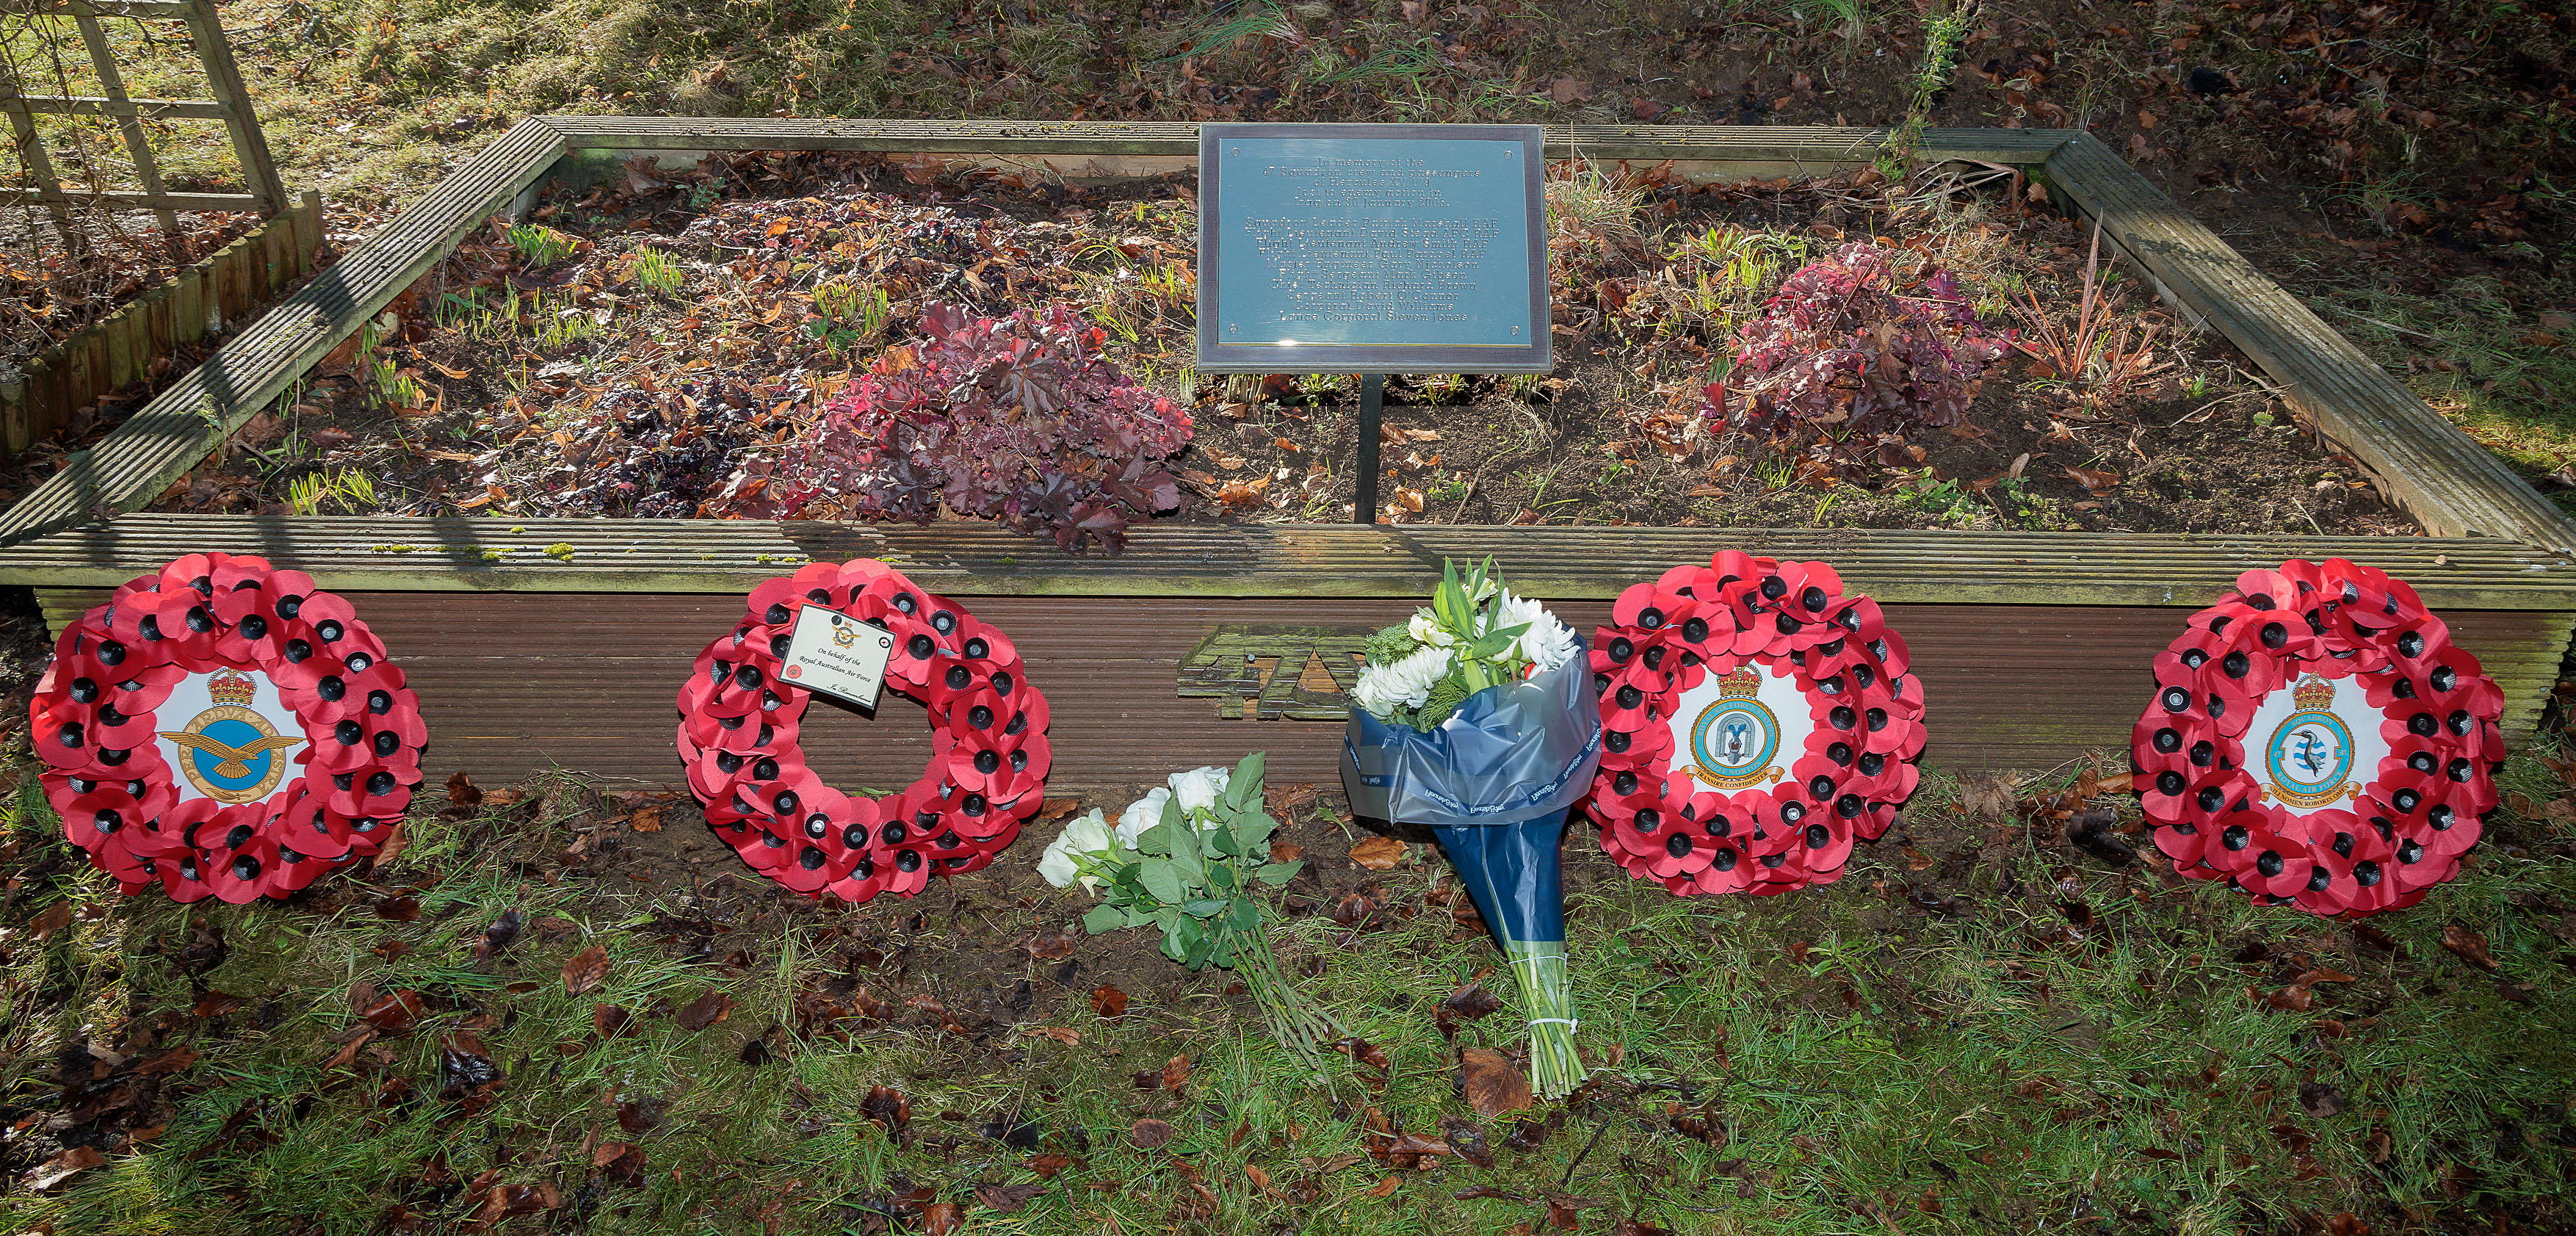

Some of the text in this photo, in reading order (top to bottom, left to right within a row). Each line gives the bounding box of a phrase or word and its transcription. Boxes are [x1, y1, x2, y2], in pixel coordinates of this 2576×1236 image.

[1318, 156, 1425, 167] In memory of the
[1262, 166, 1275, 176] 47
[1280, 166, 1342, 178] Squadron
[1380, 167, 1403, 177] and
[1408, 169, 1480, 178] passengers
[1314, 176, 1430, 187] of Hercules XV 179
[1298, 186, 1441, 198] lost to enemy action in
[1295, 196, 1321, 208] Iraq
[1345, 197, 1358, 206] 30
[1364, 198, 1414, 208] January
[1418, 197, 1450, 208] 2005.
[1245, 217, 1498, 228] Squadron Leader Patrick Marshall RAF
[1245, 227, 1499, 239] Flight Lieutenant David Stead AFC RAF
[1256, 237, 1488, 248] Flight Lieutenant Andrew Smith RAF
[1259, 247, 1486, 259] Flight Lieutenant Paul Pardoel RAF
[1267, 258, 1479, 270] Master Engineer Gary Nicholson
[1279, 268, 1467, 280] Flight Sergeant Mark Gibson
[1269, 278, 1477, 290] Chief Technician Richard Brown
[1287, 289, 1459, 300] Sergeant Robert O'Connor
[1293, 300, 1453, 311] Corporal David Williams
[1279, 311, 1468, 322] Lance Corporal Steven Jones
[828, 650, 846, 661] behalf
[853, 658, 861, 666] the
[799, 656, 817, 664] Royal
[815, 660, 845, 673] Australian
[856, 673, 871, 682] Force
[1697, 701, 1775, 737] ROYAL AIR FORCE STATION
[2290, 715, 2334, 727] SQUADRON
[181, 748, 201, 782] PER
[191, 707, 247, 731] ARDVA
[251, 718, 274, 737] AD
[1704, 759, 1762, 776] BRIZE NORTON
[1696, 770, 1769, 788] TRANSIRE CONFIDENTER
[2276, 770, 2342, 793] ROYAL AIR FORCE
[2280, 793, 2304, 806] NOMEN
[2304, 796, 2333, 806] ROBORIS
[2333, 785, 2351, 798] OMEN
